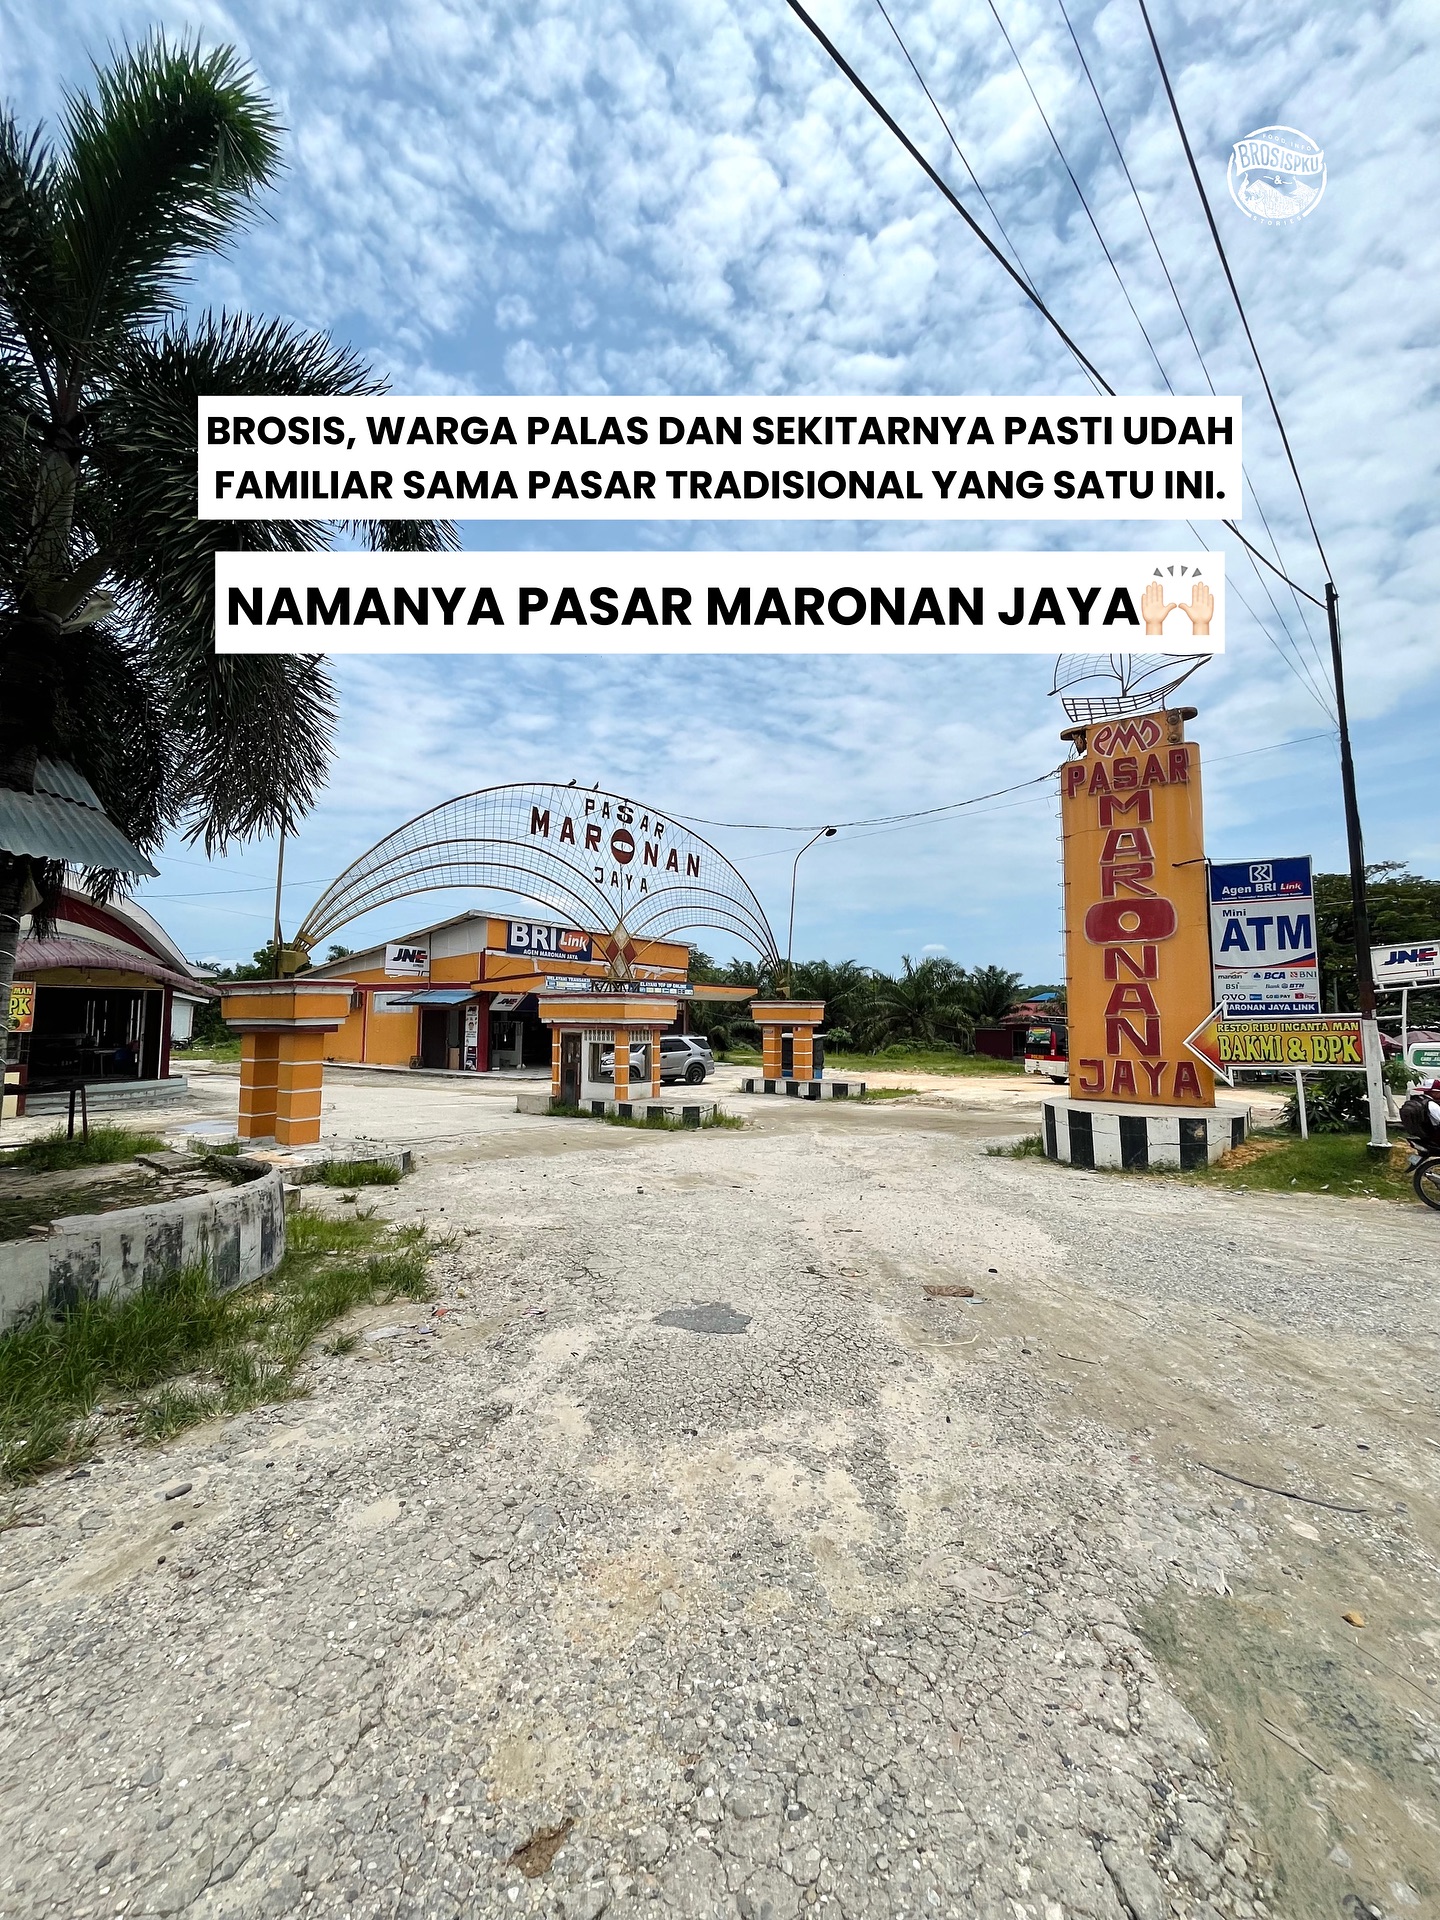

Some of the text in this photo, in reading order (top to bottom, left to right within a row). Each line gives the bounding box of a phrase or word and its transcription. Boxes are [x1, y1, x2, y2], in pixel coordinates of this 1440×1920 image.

[1067, 748, 1190, 799] PASAR
[585, 798, 665, 840] PASAR
[530, 806, 701, 878] MARONAN
[594, 866, 649, 894] JAYA
[1221, 886, 1252, 896] Agen
[1255, 882, 1277, 893] BRI
[1280, 882, 1302, 891] Link
[1222, 908, 1247, 917] Mini
[1085, 789, 1178, 1056] MARONAN
[510, 921, 588, 952] BRI Link
[1219, 913, 1312, 953] ATM
[391, 948, 428, 964] JNE
[540, 951, 566, 959] MARONAN
[1380, 947, 1438, 966] JNE
[1263, 971, 1286, 980] BCA
[13, 987, 32, 995] MAN
[1221, 993, 1247, 1001] OVO
[9, 997, 31, 1015] PK
[1227, 1003, 1316, 1011] ARONAN JAYA LINK
[1217, 1022, 1359, 1032] RESTO RIBU INGANTA MAN
[1218, 1035, 1362, 1063] BAKMI & BPK
[1079, 1059, 1203, 1097] JAYA
